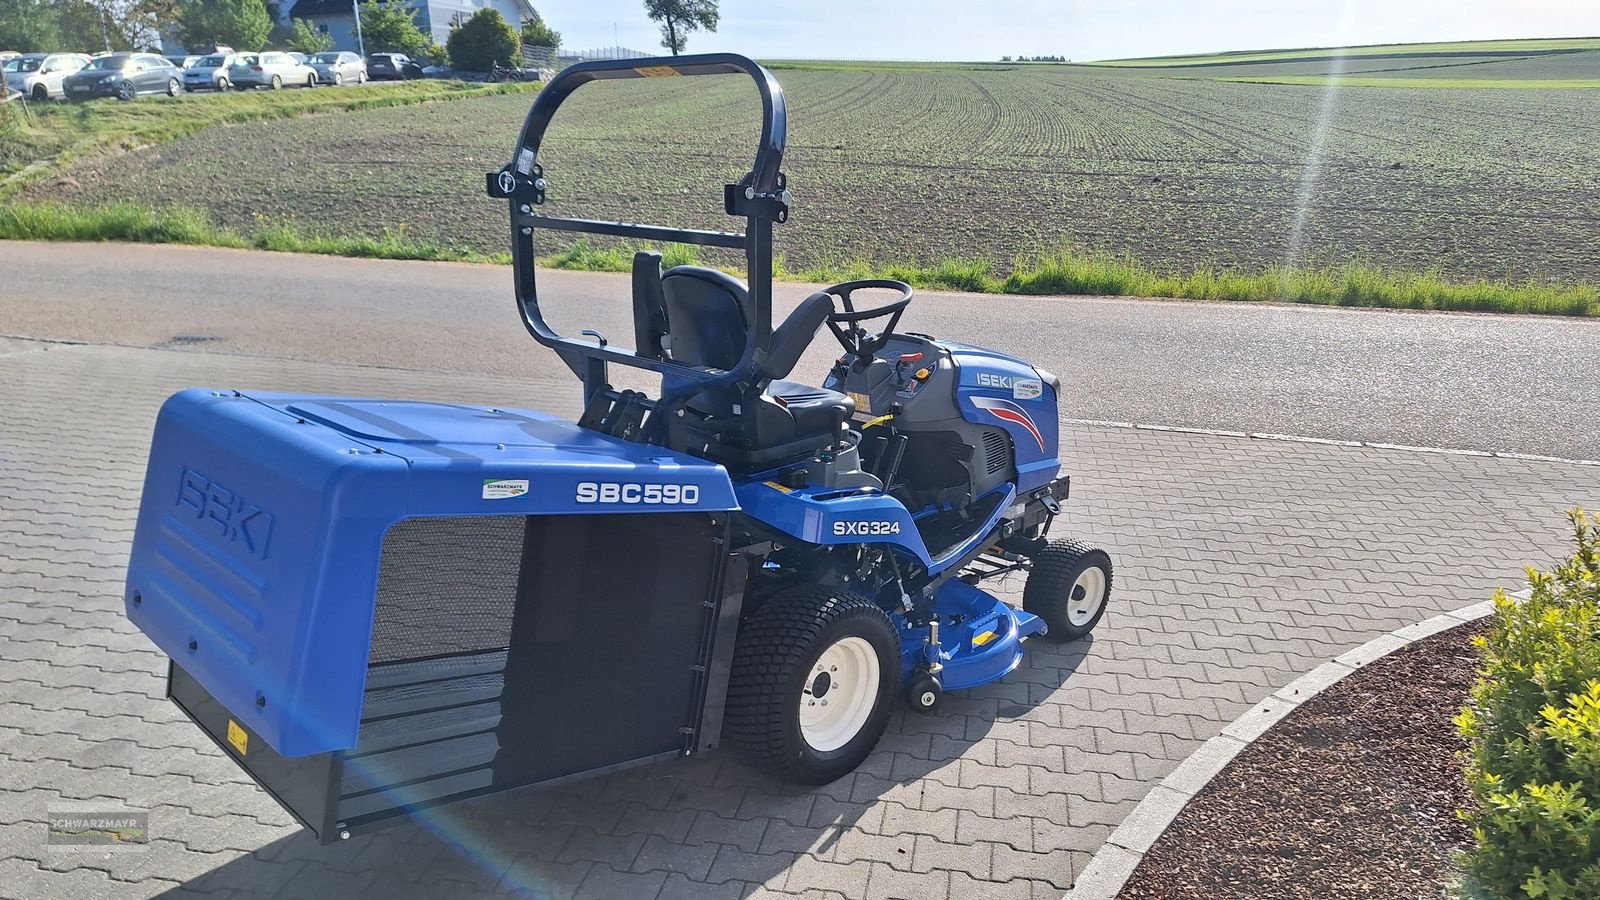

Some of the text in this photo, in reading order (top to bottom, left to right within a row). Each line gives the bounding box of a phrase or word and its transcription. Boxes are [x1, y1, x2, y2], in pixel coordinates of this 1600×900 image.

[976, 372, 1013, 389] ISEKI
[575, 482, 700, 504] SBC590
[175, 464, 276, 561] ISEKI
[832, 520, 901, 535] SXG324
